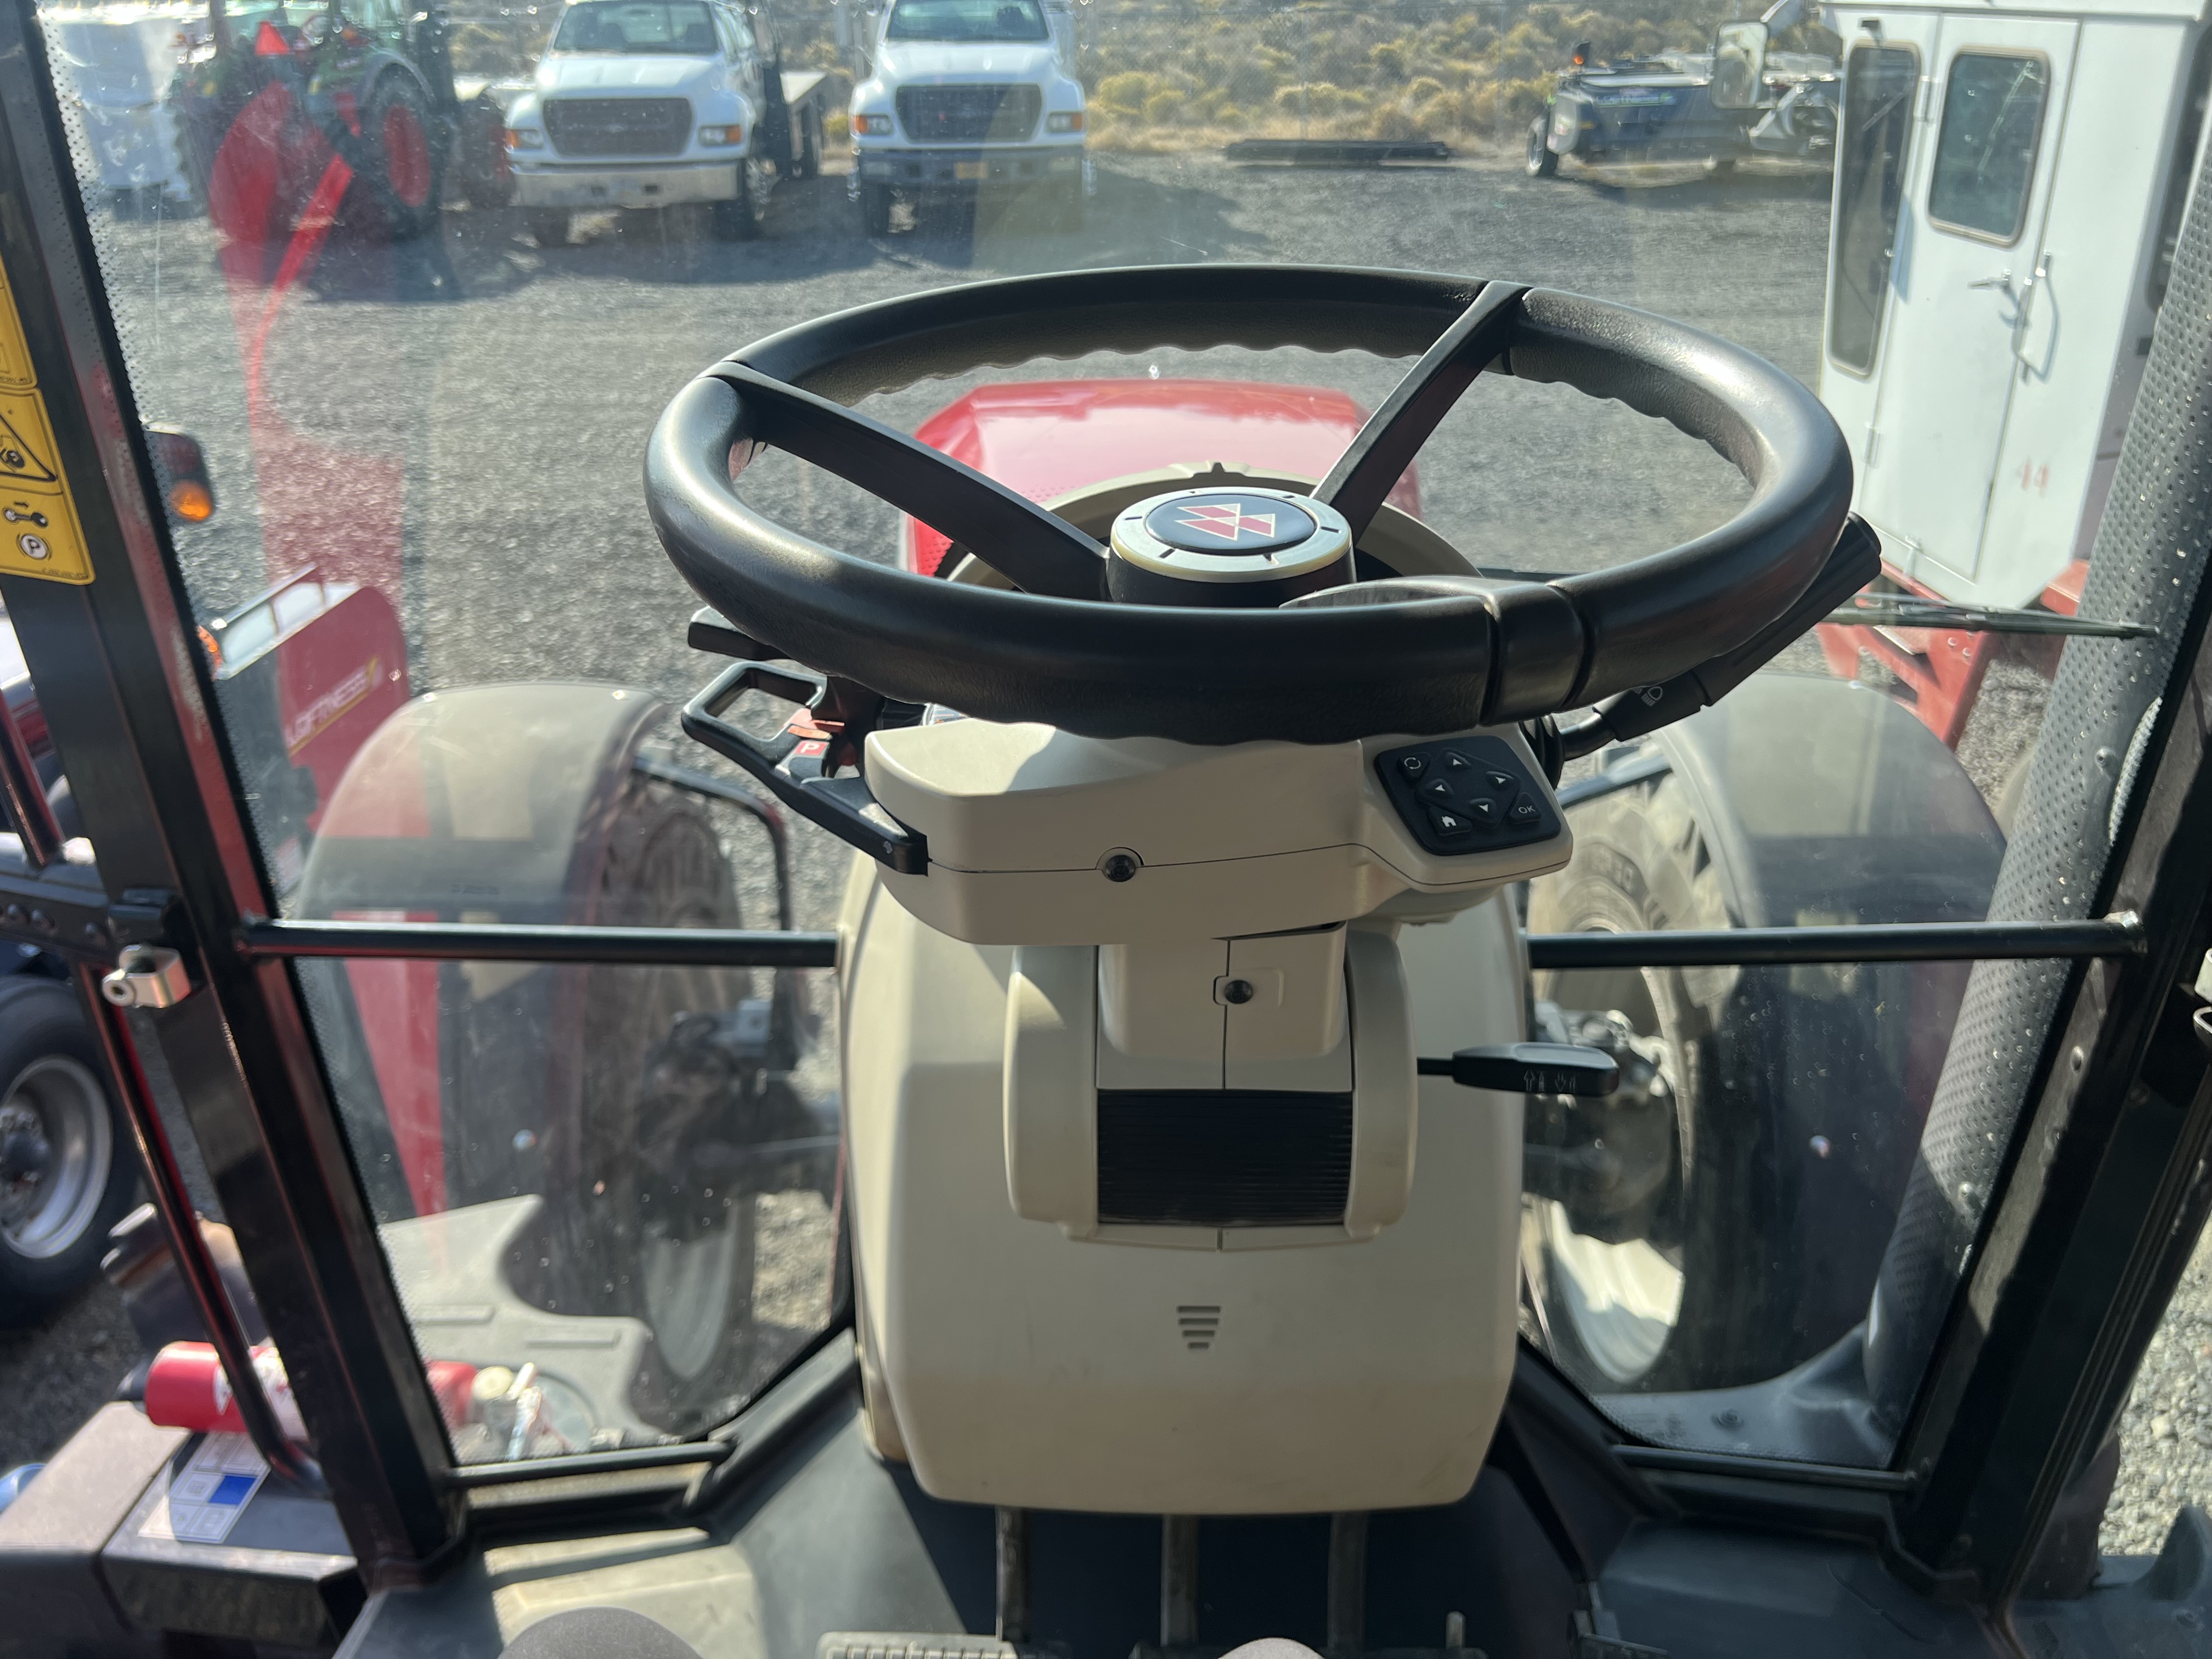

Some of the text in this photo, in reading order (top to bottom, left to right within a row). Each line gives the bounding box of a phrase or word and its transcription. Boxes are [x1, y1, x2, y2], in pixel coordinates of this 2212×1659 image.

[27, 538, 40, 556] P
[800, 742, 820, 753] P
[1518, 805, 1536, 814] OK
